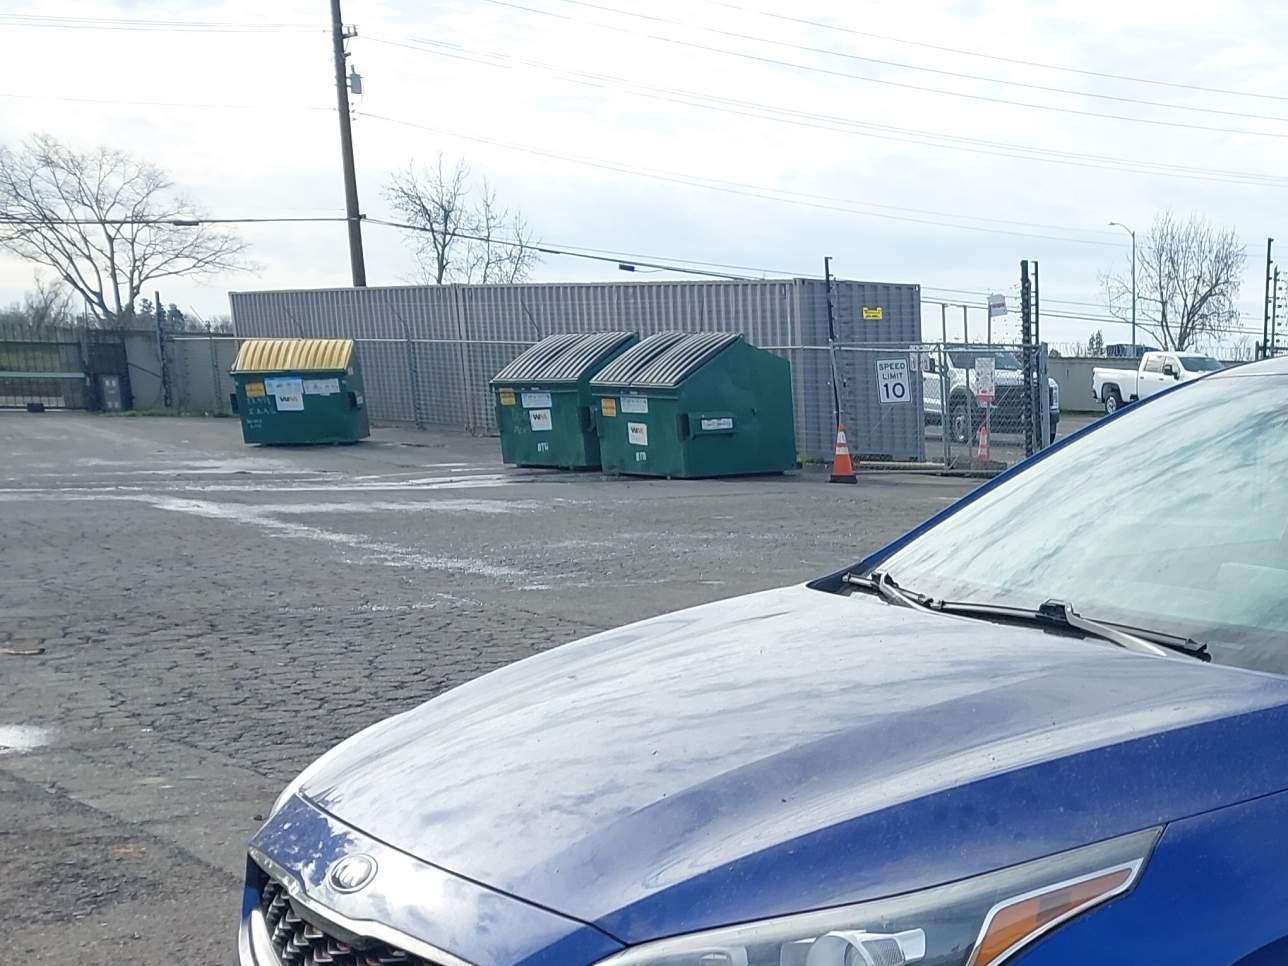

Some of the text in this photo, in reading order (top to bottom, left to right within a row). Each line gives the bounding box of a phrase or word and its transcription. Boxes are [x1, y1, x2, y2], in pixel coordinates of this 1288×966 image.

[879, 362, 906, 370] SPEED
[882, 372, 903, 380] LIMIT
[883, 382, 905, 399] 10
